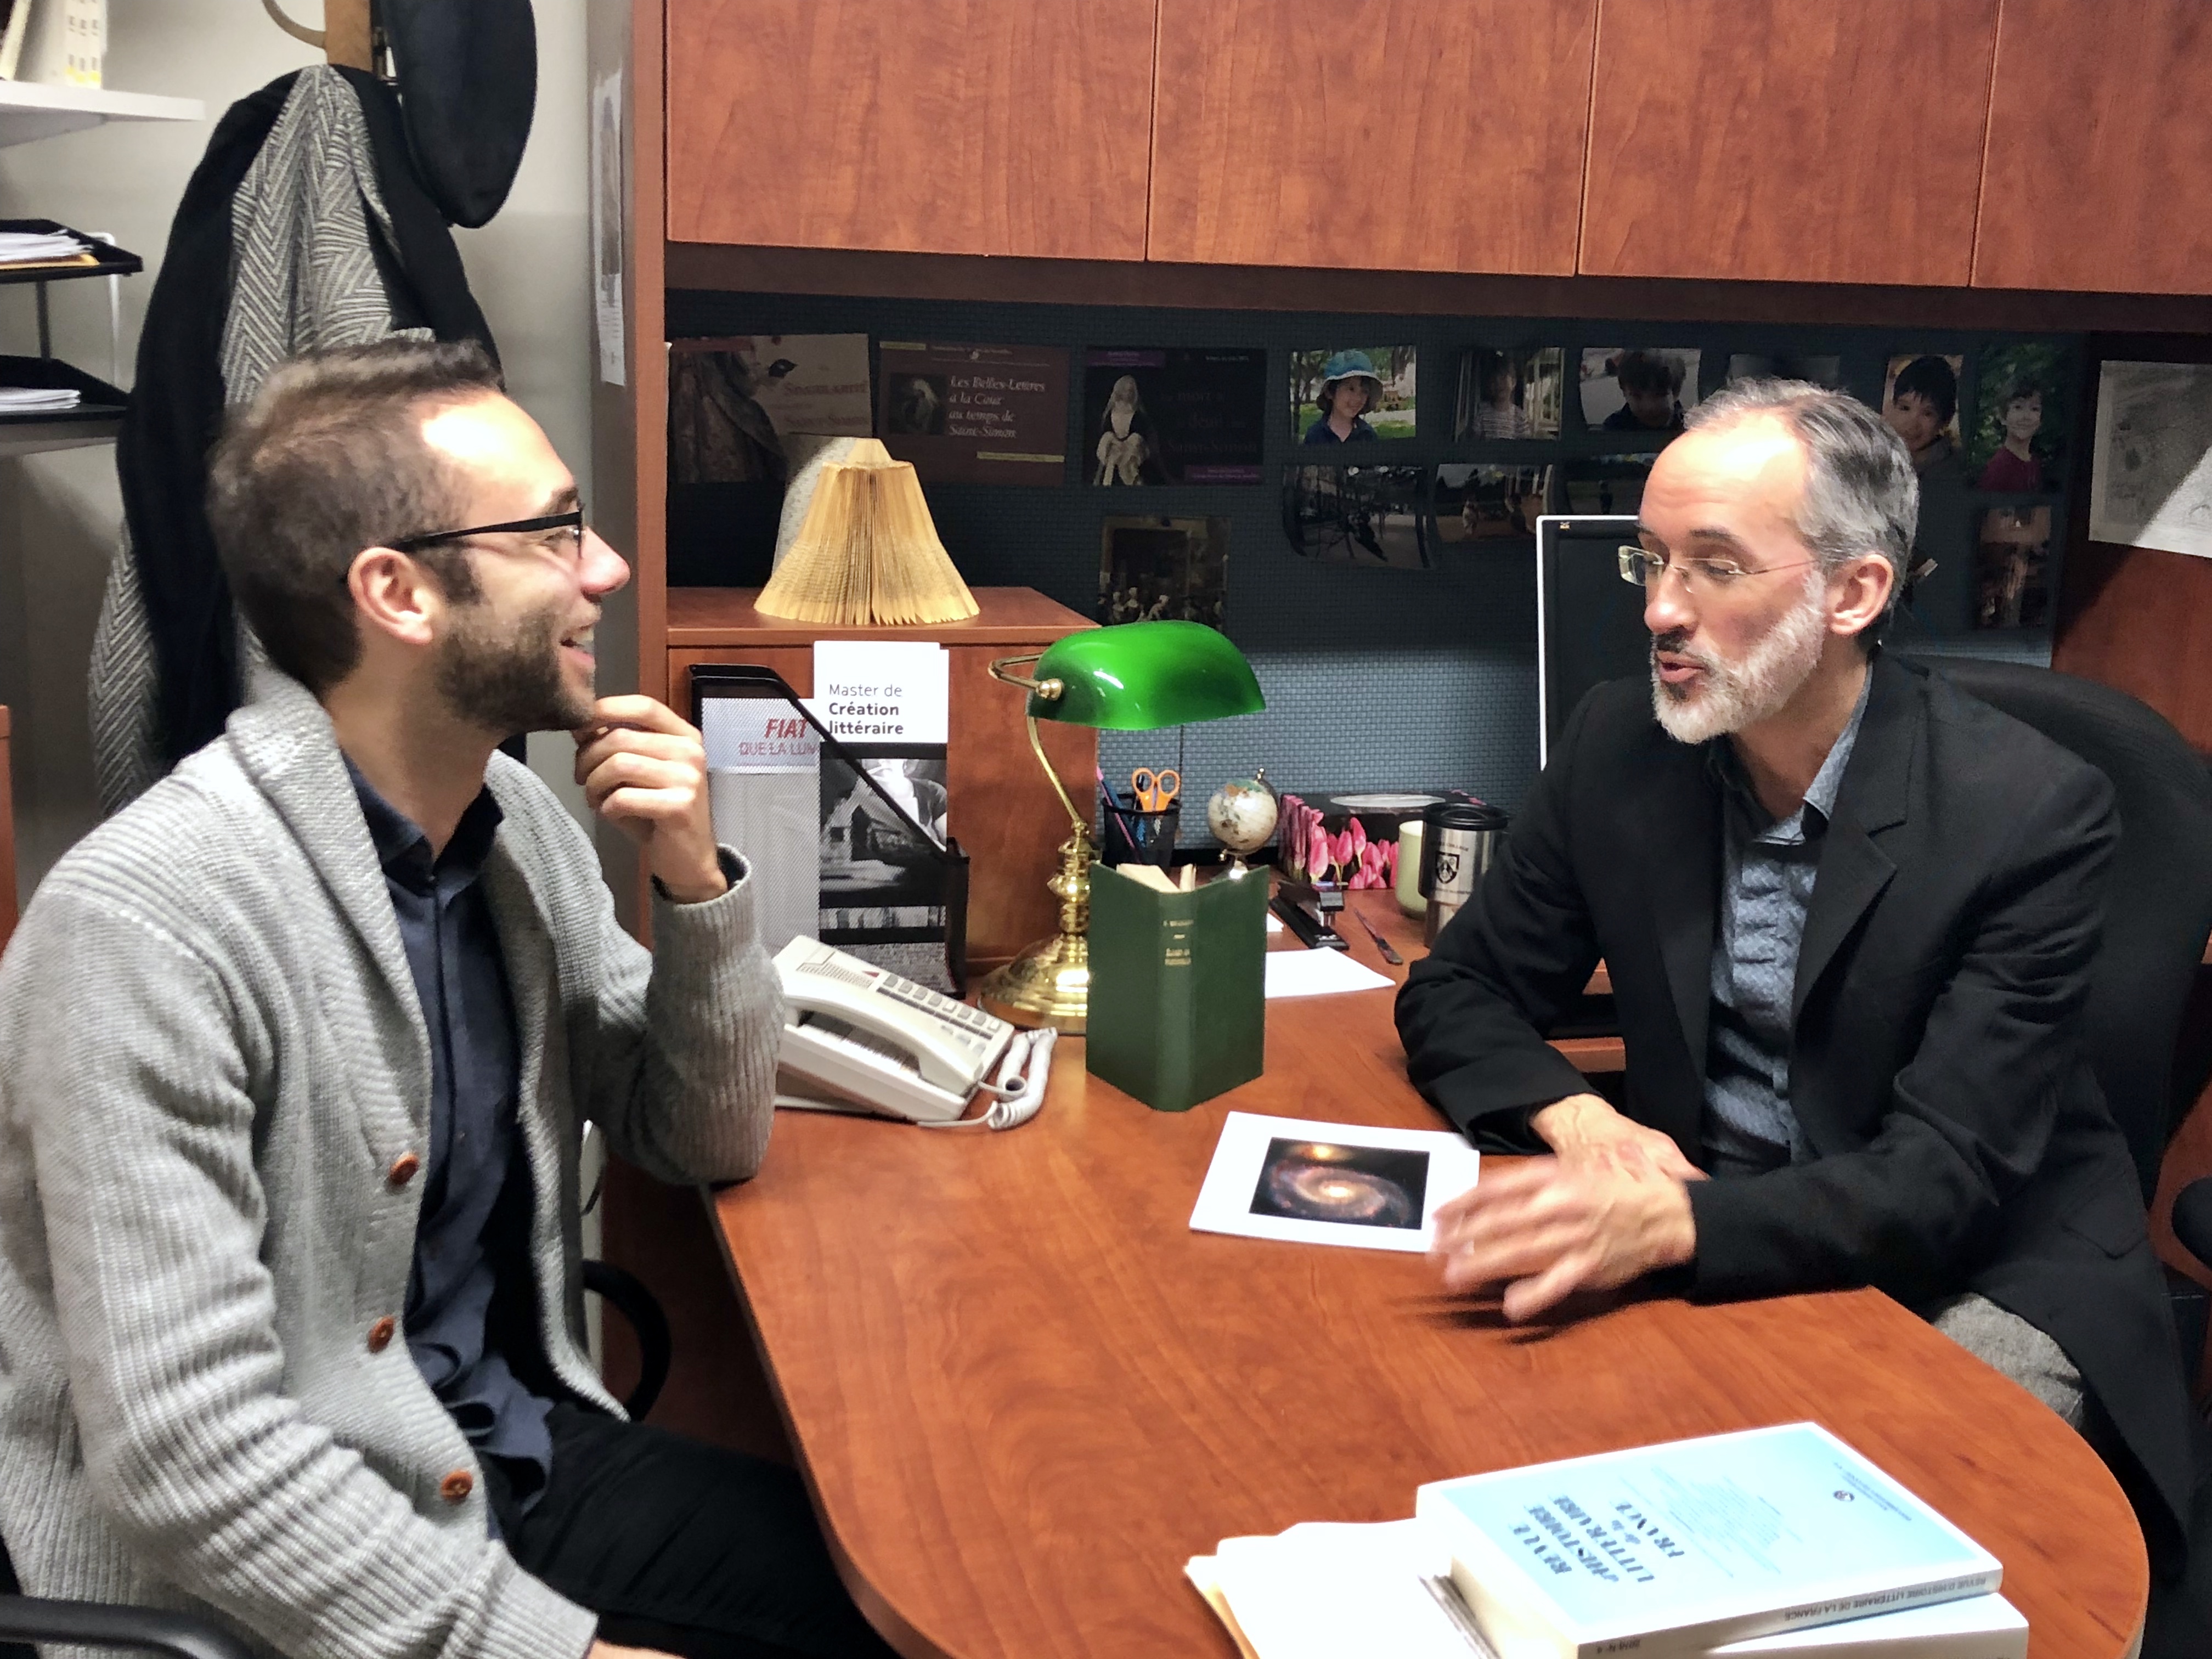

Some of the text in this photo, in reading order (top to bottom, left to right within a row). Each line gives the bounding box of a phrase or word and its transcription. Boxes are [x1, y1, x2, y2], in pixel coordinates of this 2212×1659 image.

[950, 375, 1045, 392] Les Belles-Lettres
[961, 391, 971, 404] la
[974, 393, 1004, 405] Cour
[949, 410, 1016, 424] au temps de
[949, 424, 1017, 438] Saint-Simon
[829, 684, 902, 697] Master de
[829, 701, 899, 715] Création
[764, 718, 808, 738] FIAT
[829, 720, 904, 735] littéraire
[738, 742, 765, 755] QUE
[768, 742, 787, 755] LA
[1611, 1503, 1684, 1558] FRANCE
[1510, 1523, 1572, 1574] REVUE
[1957, 1577, 1986, 1589] REVUE
[1785, 1606, 1822, 1621] FRANCE
[1838, 1602, 1851, 1612] DE
